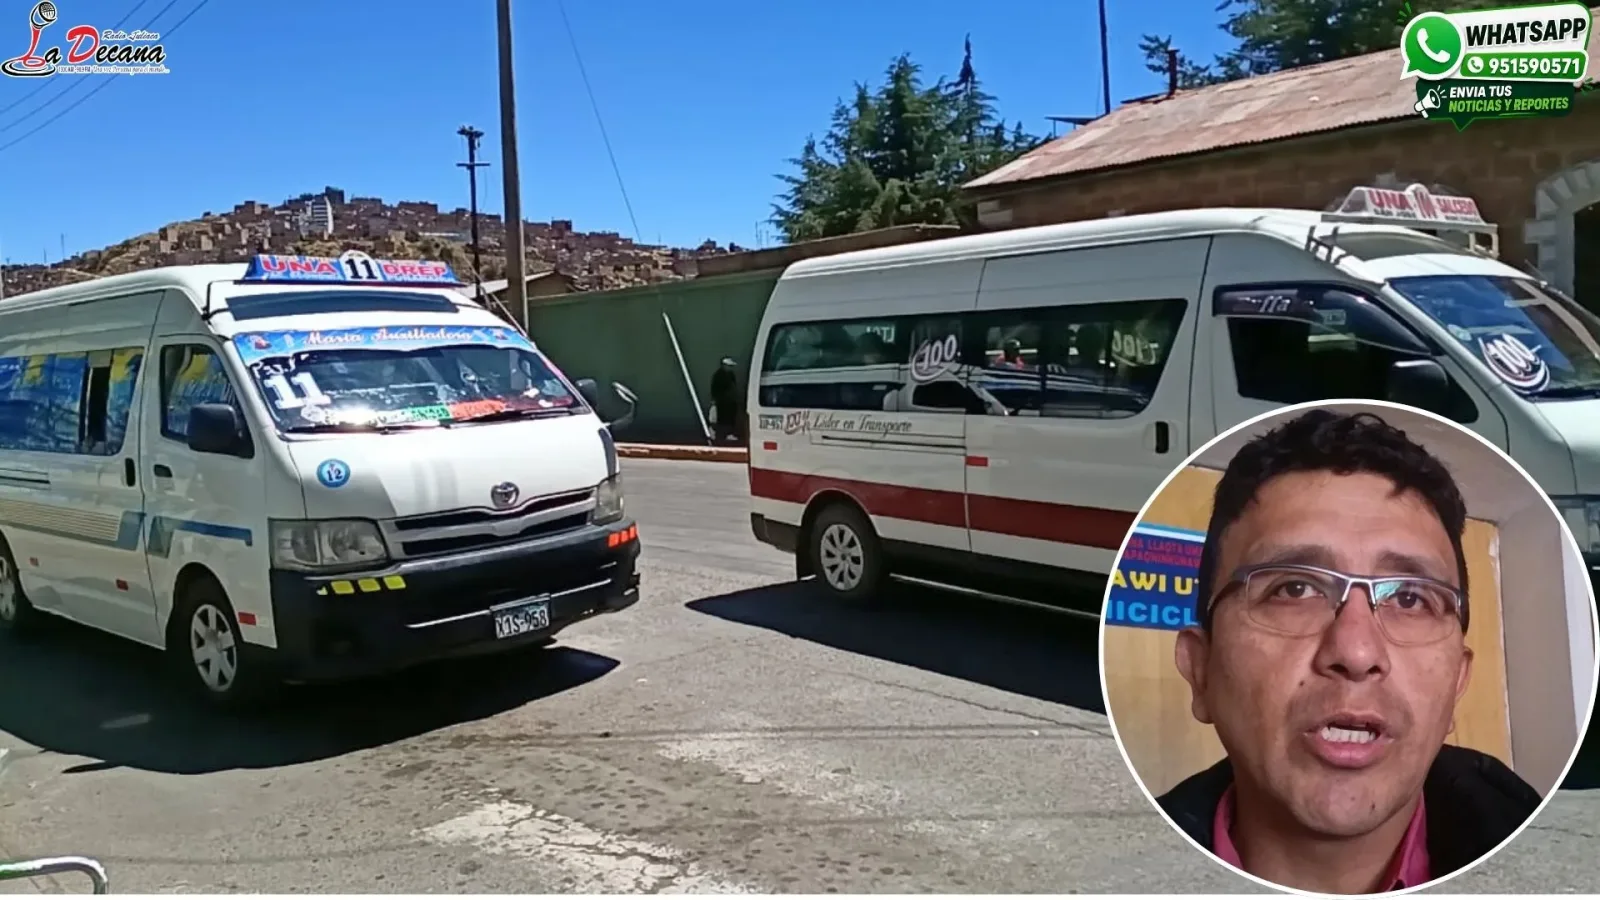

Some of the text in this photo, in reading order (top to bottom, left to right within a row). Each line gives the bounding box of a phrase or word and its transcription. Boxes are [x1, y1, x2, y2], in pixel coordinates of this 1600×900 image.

[1368, 189, 1414, 210] UNA
[261, 256, 338, 275] UNA
[345, 258, 378, 280] 11
[382, 263, 447, 277] DREP
[922, 334, 958, 370] 100
[263, 371, 332, 409] 11
[843, 419, 855, 429] en
[859, 413, 912, 437] Transporte
[327, 468, 344, 482] 12
[1174, 575, 1200, 596] U
[495, 609, 548, 638] X1S-958
